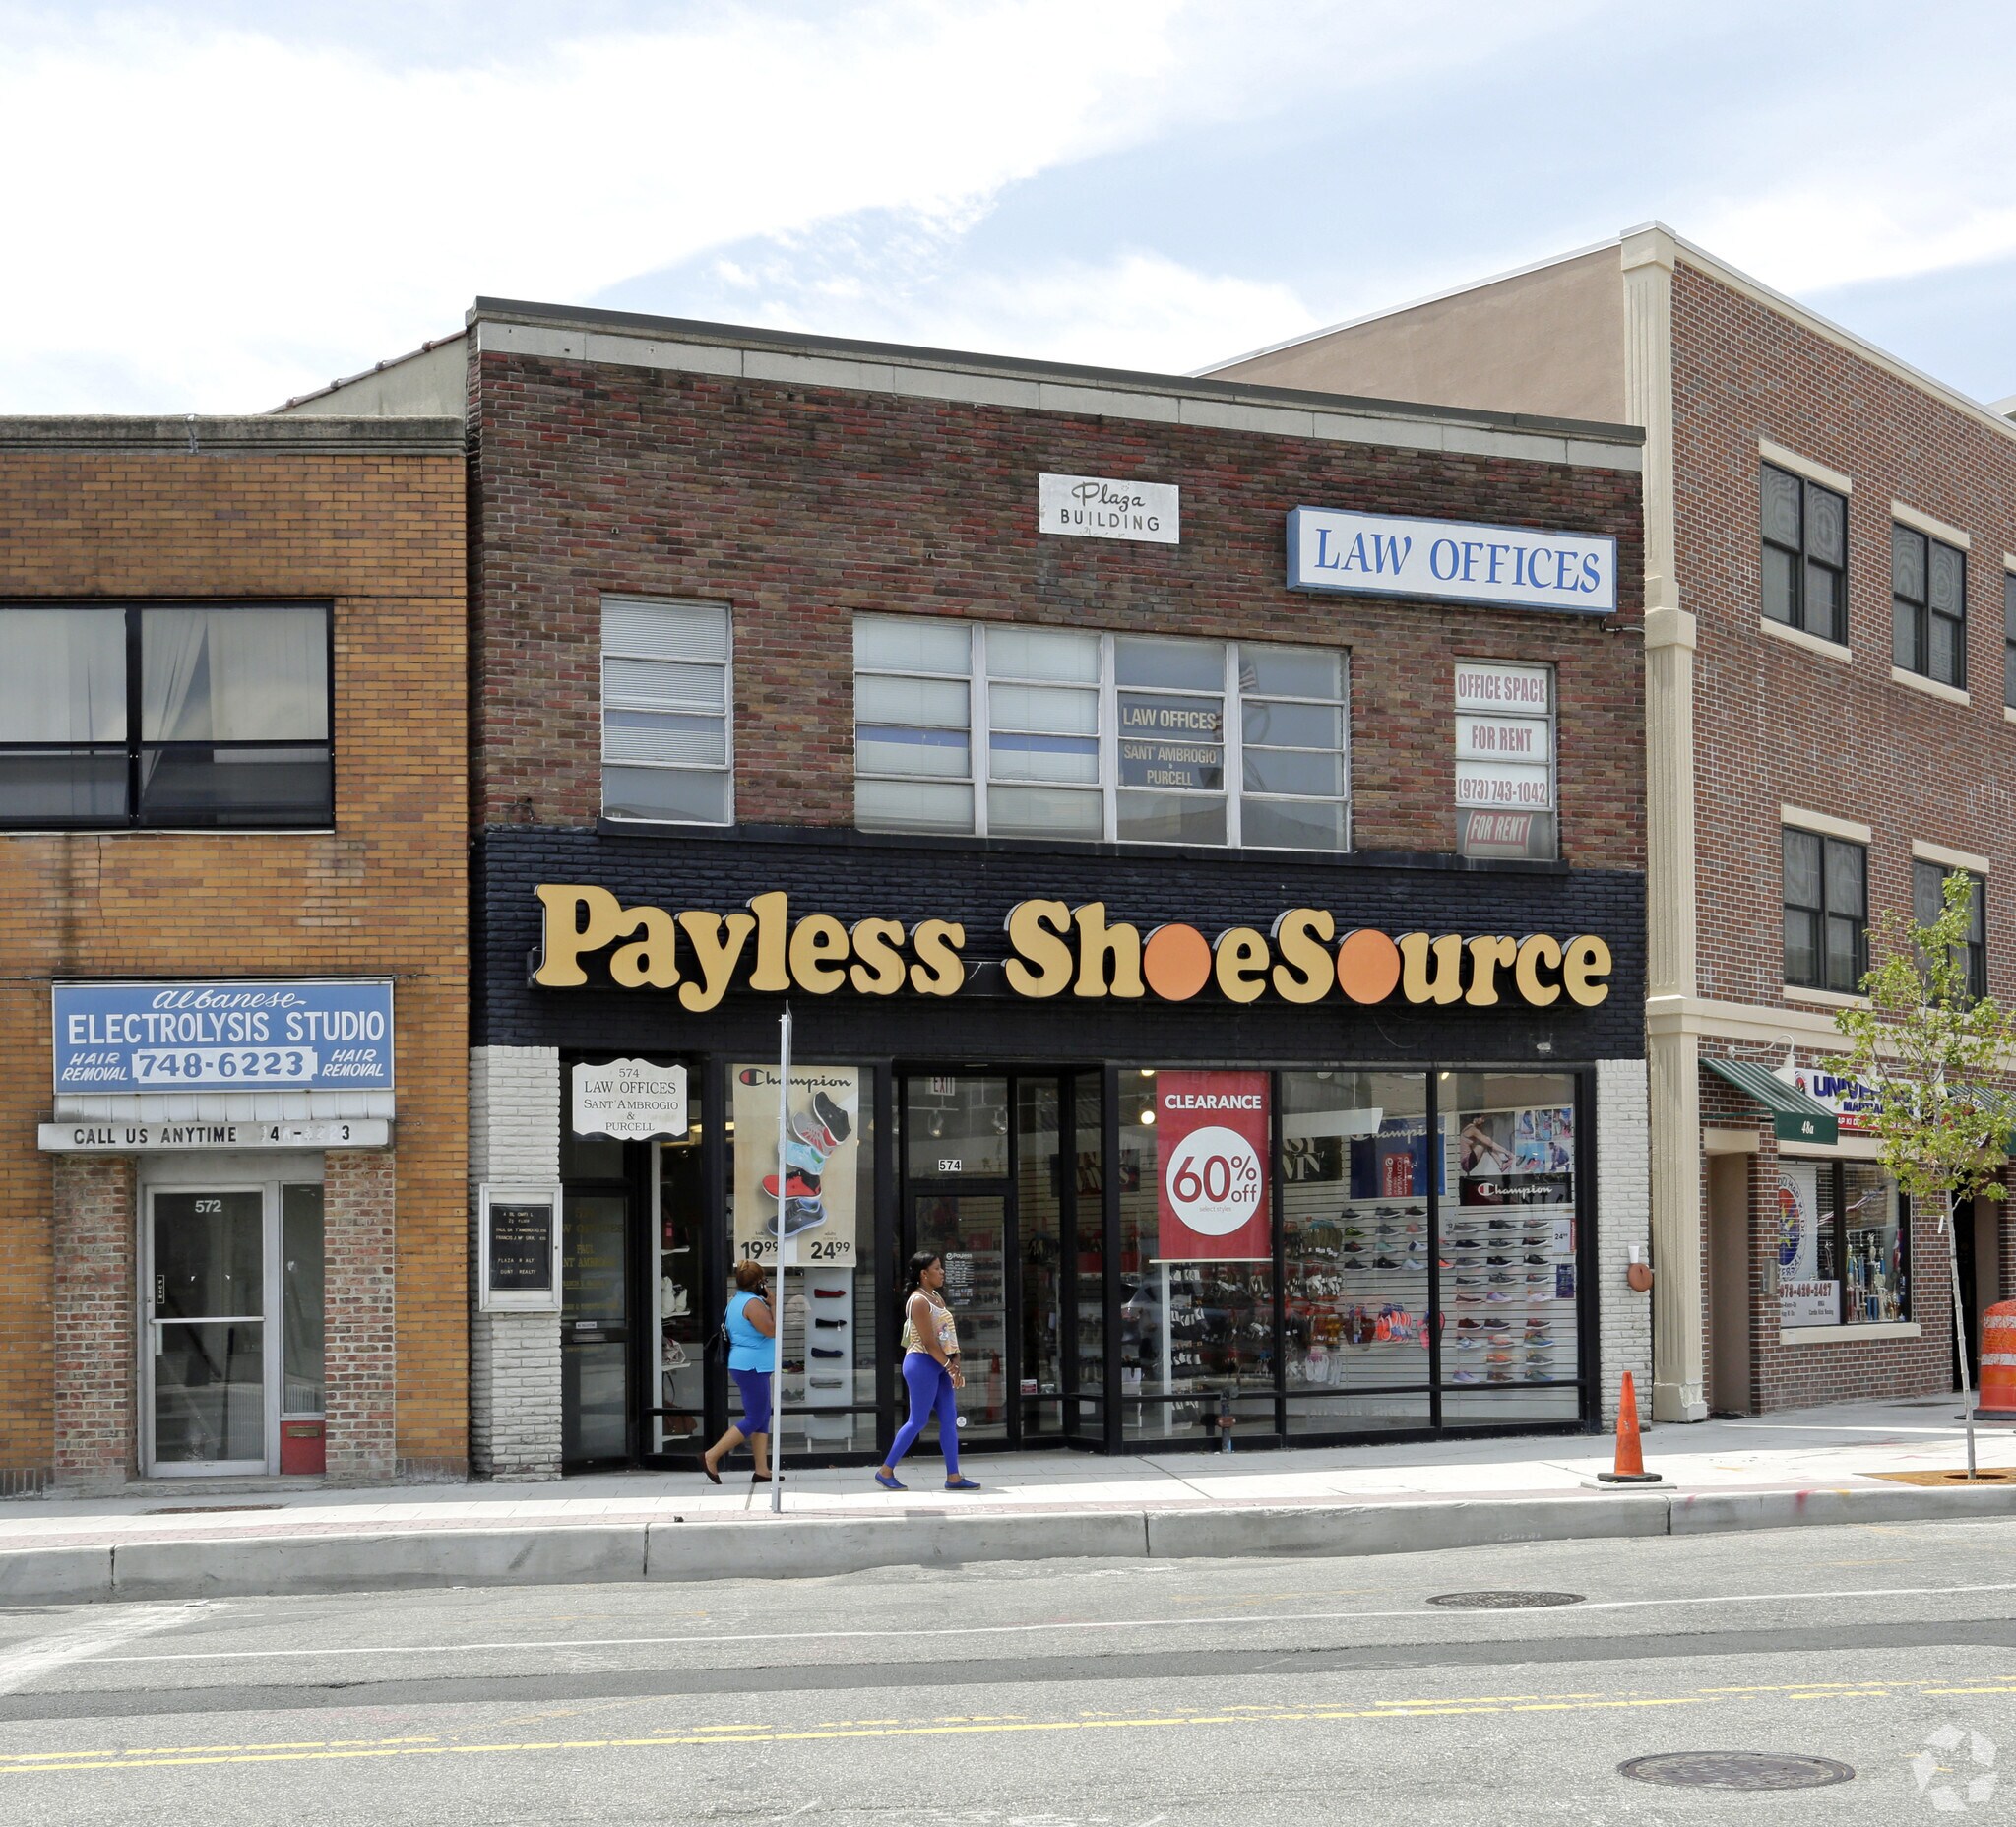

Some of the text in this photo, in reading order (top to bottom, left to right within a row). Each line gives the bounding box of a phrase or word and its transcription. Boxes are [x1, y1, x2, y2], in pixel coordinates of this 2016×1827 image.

[1071, 481, 1146, 512] Plaza
[1060, 509, 1160, 532] BUILDING
[1314, 528, 1601, 594] LAW OFFICES
[1459, 673, 1545, 703] OFFICE SPACE
[1123, 707, 1217, 730] LAW OFFICES
[1472, 724, 1533, 752] FOR RENT
[1147, 770, 1193, 786] PURCELL
[1459, 778, 1545, 803] (973) 743-1042
[1470, 814, 1527, 842] FOR RENT
[533, 883, 1612, 1013] Payless ShoeSource
[68, 1011, 385, 1044] ELECTROLYSIS STUDIO
[70, 1052, 121, 1066] HAIR
[138, 1051, 304, 1078] 748-6223
[331, 1049, 377, 1062] HAIR
[61, 1068, 128, 1082] REMOVAL
[321, 1063, 385, 1077] REMOVAL
[618, 1068, 640, 1078] 574
[584, 1081, 677, 1095] LAW OFFICES
[739, 1068, 852, 1093] Chmpion
[1165, 1094, 1262, 1109] CLEARANCE
[74, 1128, 116, 1144] CALL
[126, 1128, 148, 1143] US
[160, 1127, 237, 1143] ANYTIME
[605, 1122, 656, 1132] PURCELL
[1801, 1120, 1814, 1135] 48a
[939, 1161, 961, 1170] 574
[1172, 1155, 1257, 1203] 60%
[1231, 1184, 1258, 1203] off
[1478, 1182, 1553, 1199] Champion
[195, 1199, 222, 1213] 572
